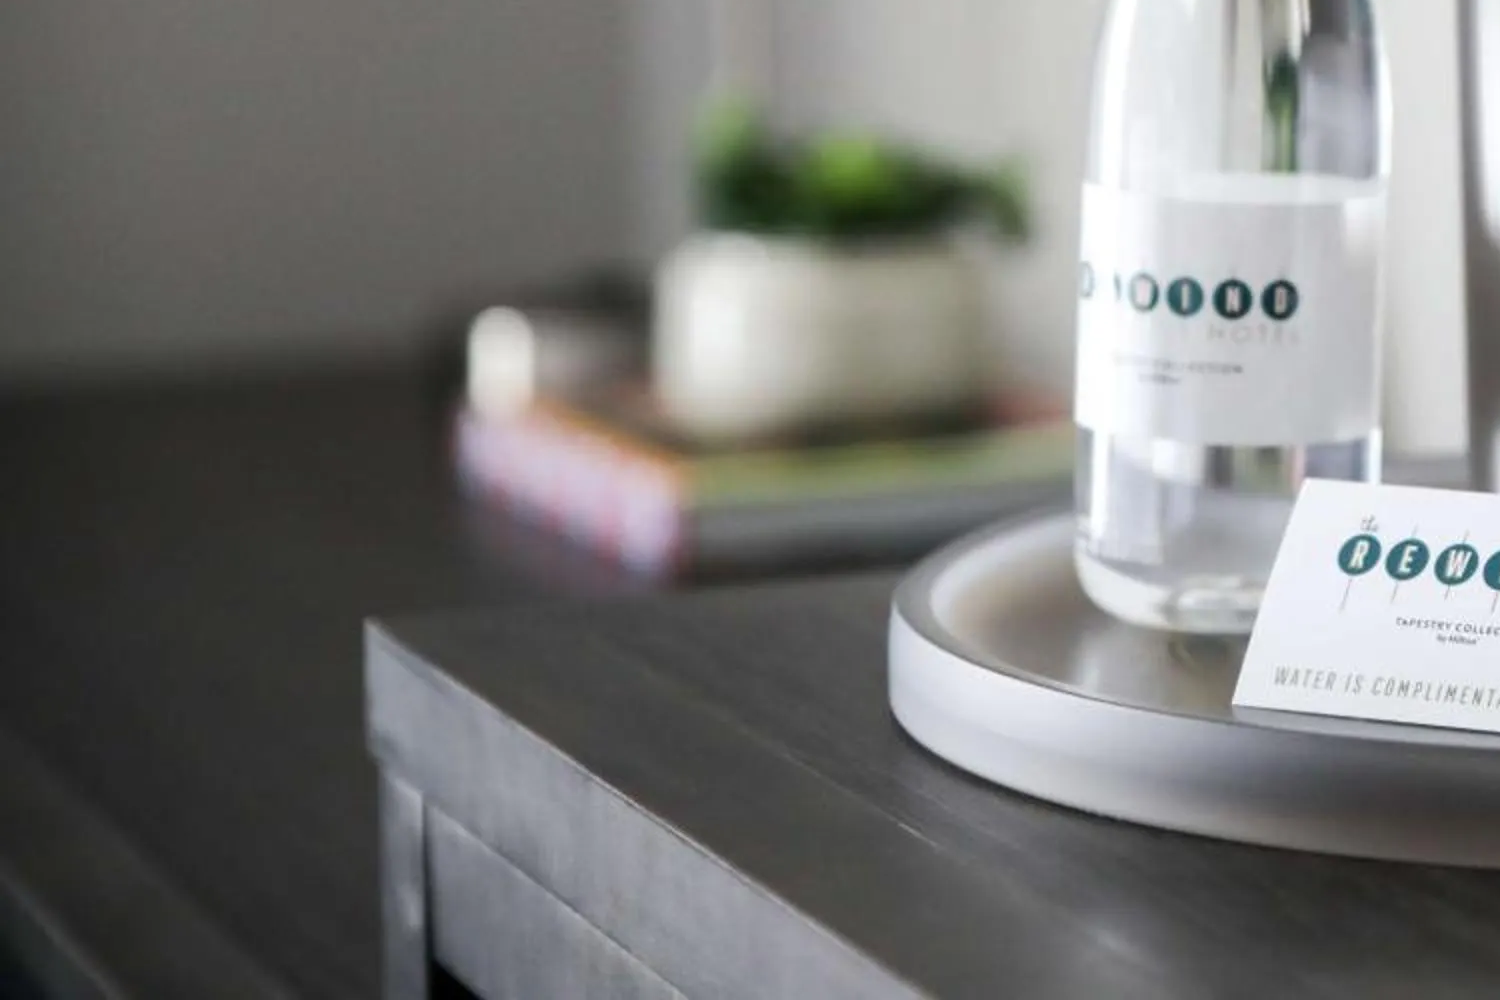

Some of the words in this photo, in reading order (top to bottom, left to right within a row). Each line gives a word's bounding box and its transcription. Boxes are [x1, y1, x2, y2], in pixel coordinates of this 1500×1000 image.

[1395, 616, 1452, 632] TAPESTRY
[1272, 664, 1337, 694] WATER
[1343, 671, 1363, 697] IS
